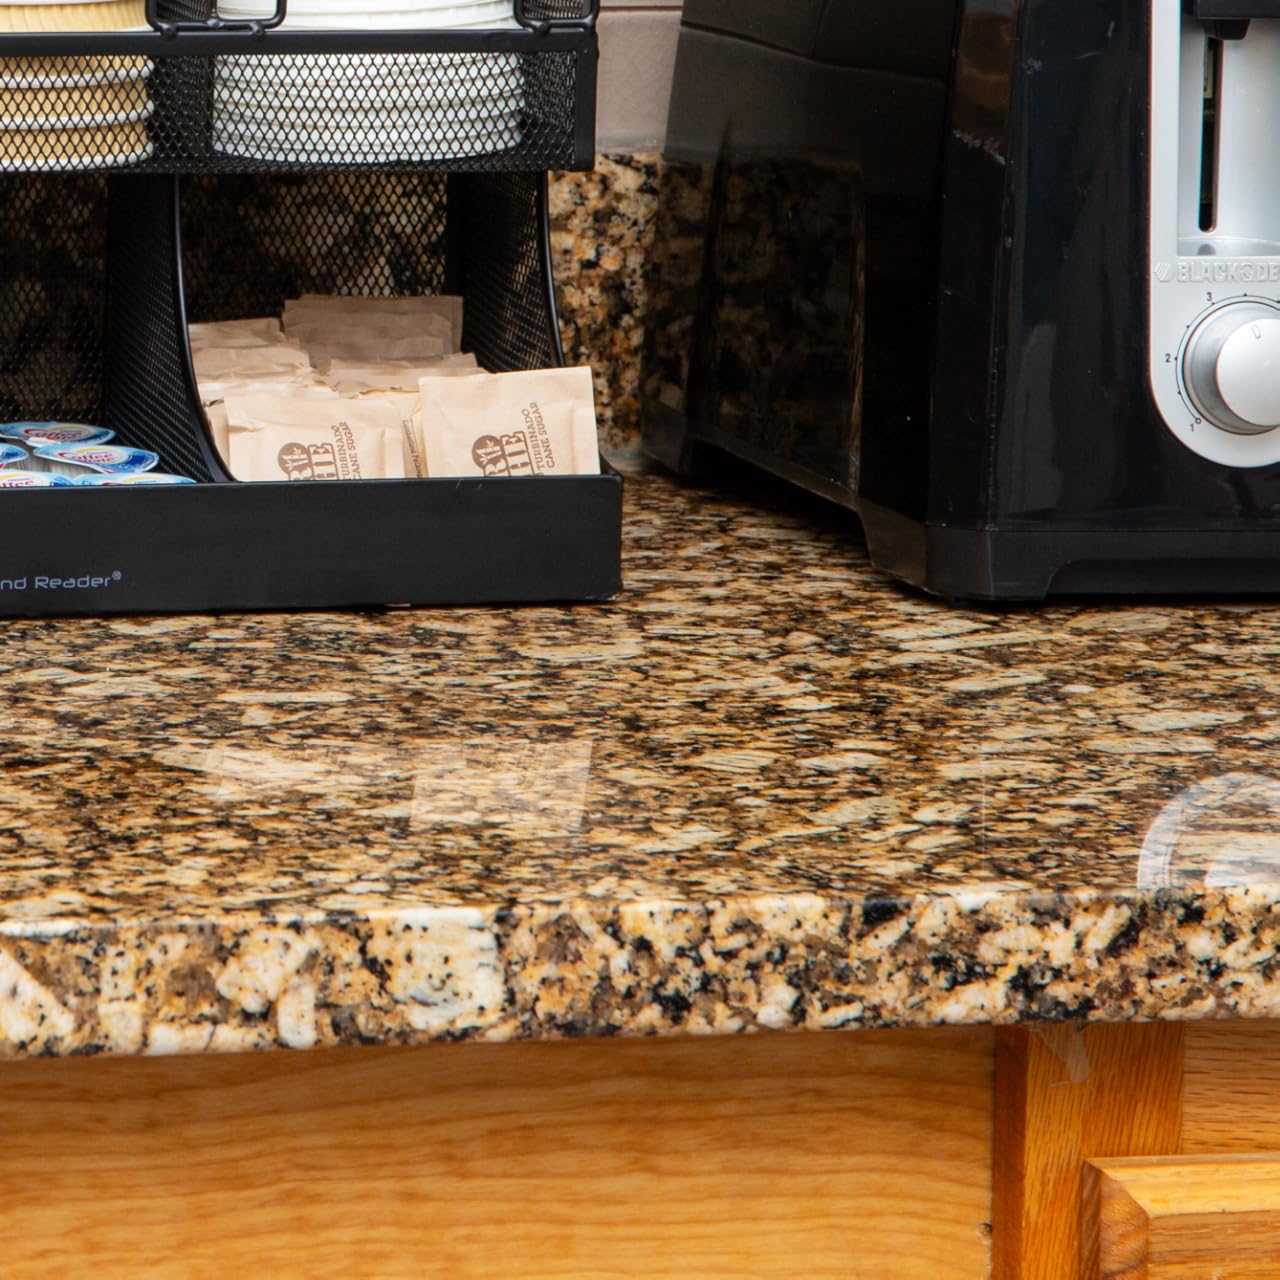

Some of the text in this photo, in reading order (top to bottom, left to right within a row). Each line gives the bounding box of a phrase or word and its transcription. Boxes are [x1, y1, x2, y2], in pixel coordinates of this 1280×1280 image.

[1206, 291, 1213, 302] 3
[1165, 353, 1171, 363] 2
[339, 421, 357, 452] SUGAR
[530, 401, 555, 469] CANE SUGAR
[1190, 423, 1195, 432] 1
[521, 408, 545, 471] TURBINADO
